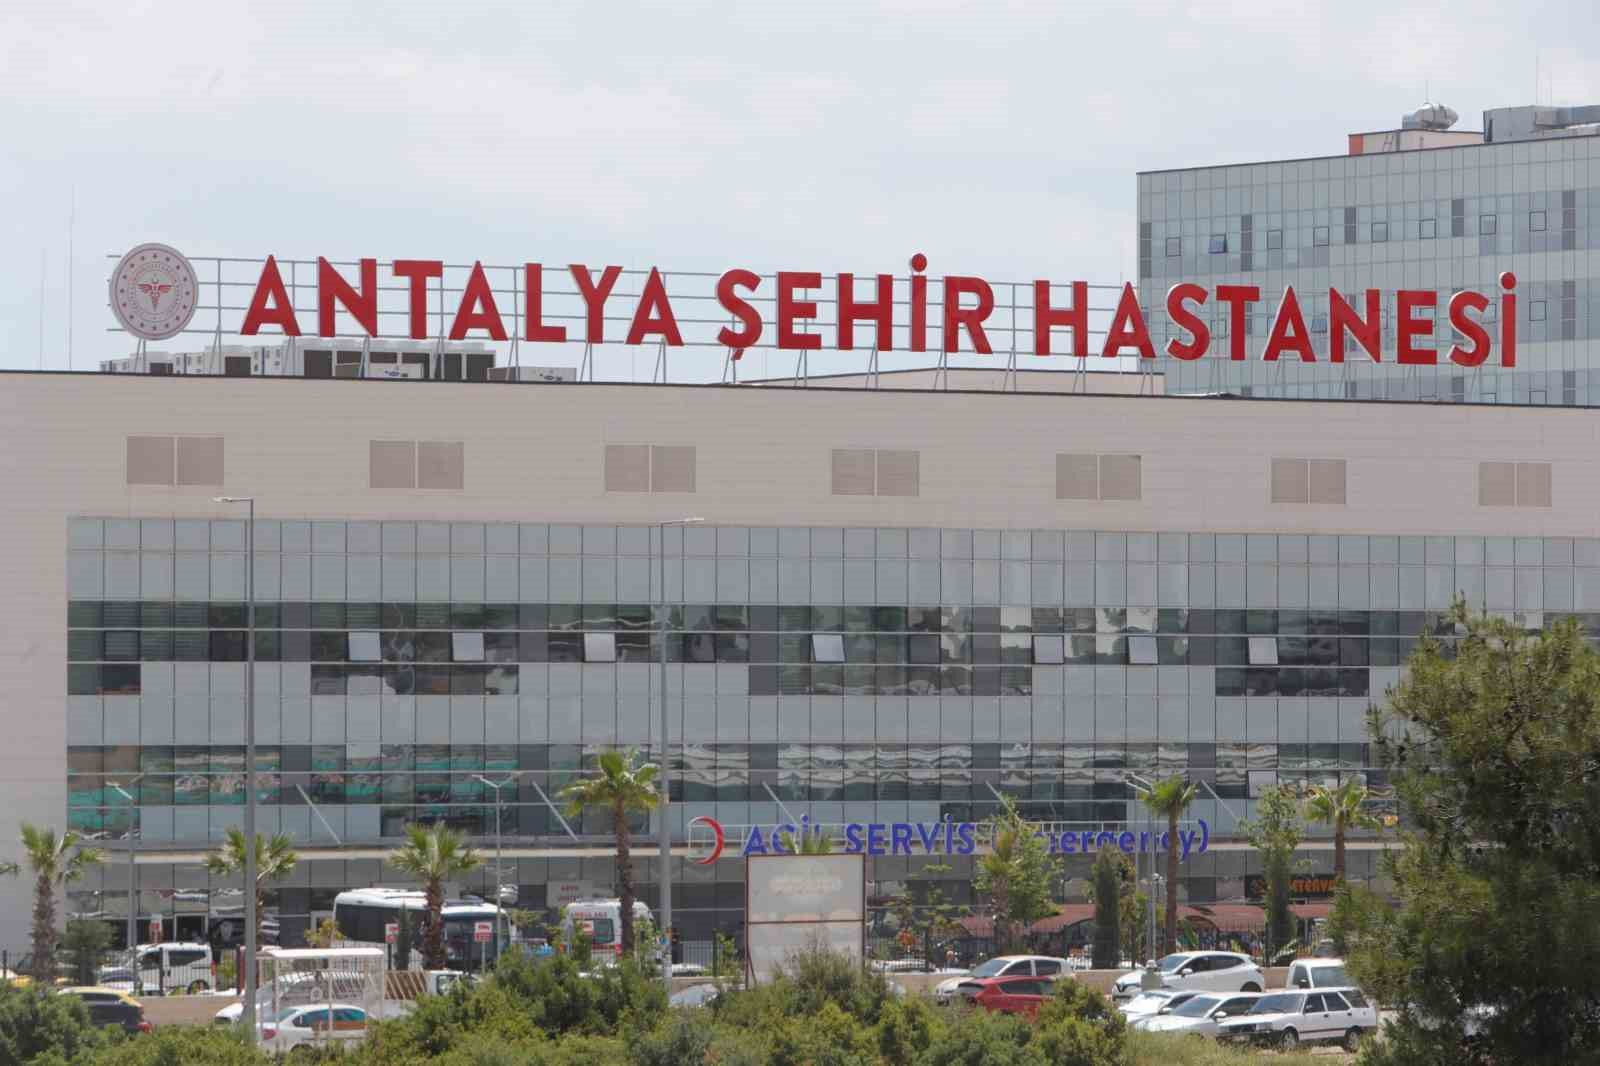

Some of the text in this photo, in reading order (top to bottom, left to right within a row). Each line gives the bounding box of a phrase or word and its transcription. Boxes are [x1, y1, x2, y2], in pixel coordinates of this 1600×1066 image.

[240, 255, 683, 346] ANTALYA
[715, 253, 995, 361] ŞEHİR
[1033, 271, 1518, 368] HASTANESİ
[845, 813, 976, 855] SERVİS
